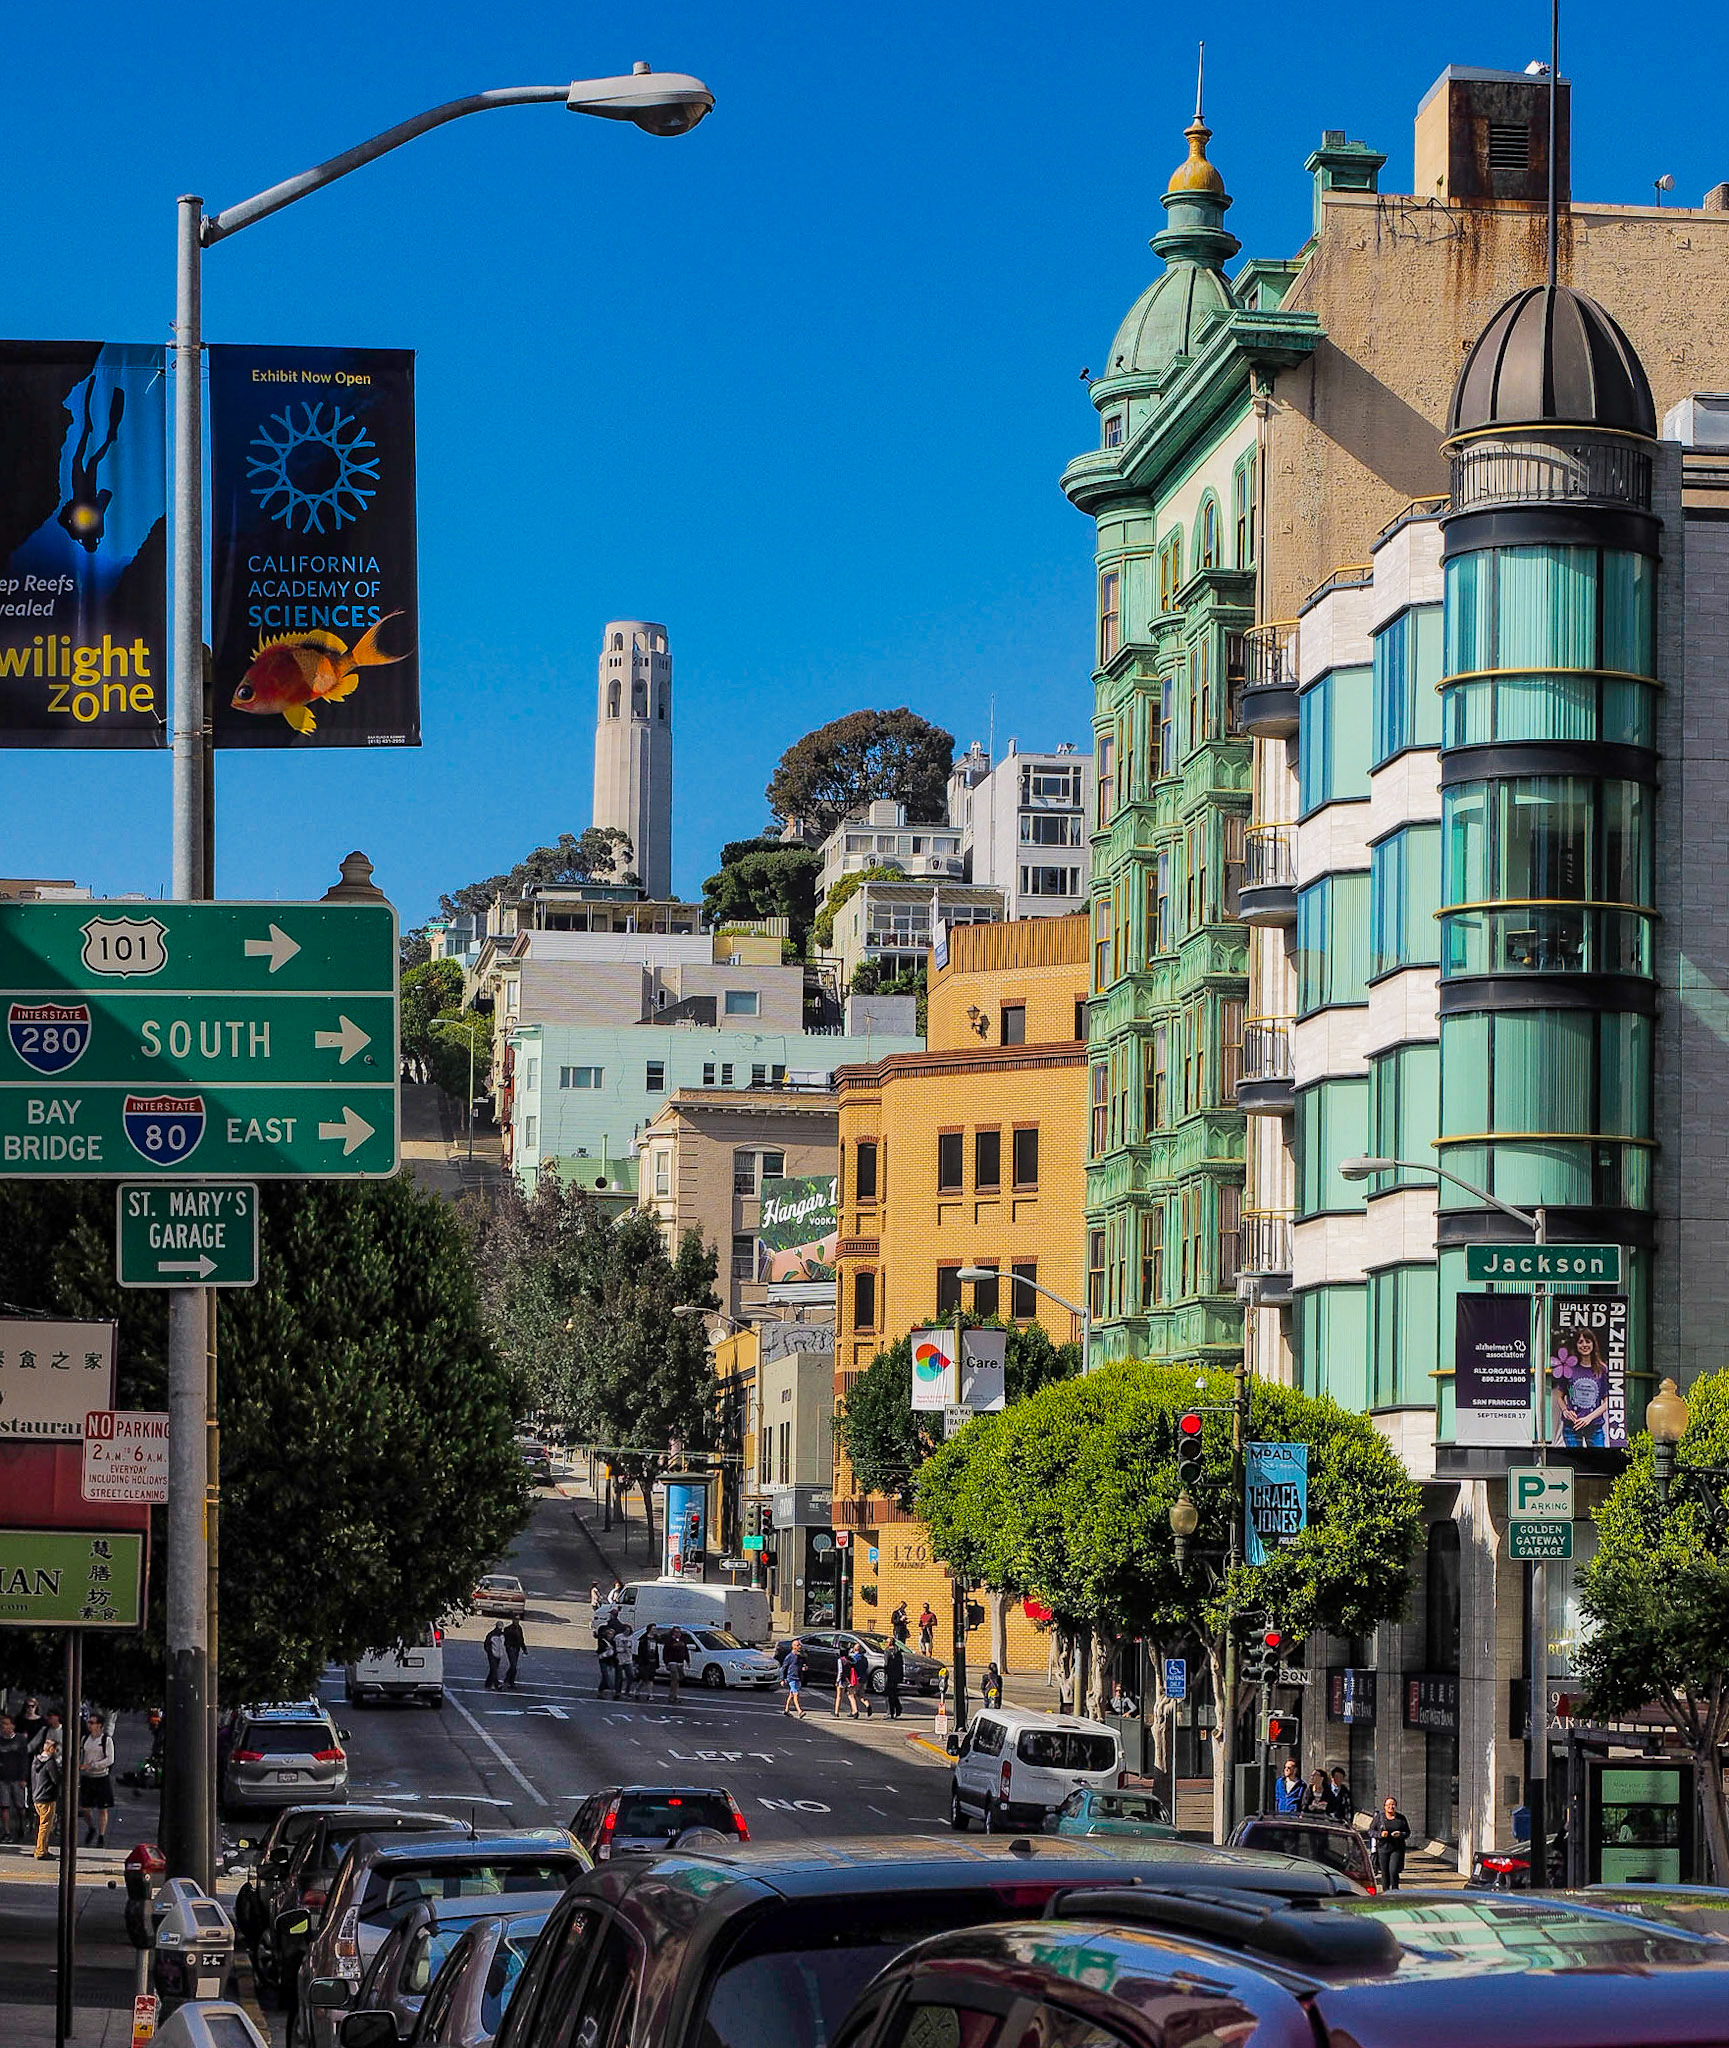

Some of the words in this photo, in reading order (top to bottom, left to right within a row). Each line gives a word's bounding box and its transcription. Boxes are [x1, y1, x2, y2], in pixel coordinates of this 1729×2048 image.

[252, 369, 298, 383] Exhibit
[301, 370, 332, 383] Now
[335, 371, 371, 386] Open
[248, 555, 380, 573] CALIFORNIA
[24, 575, 74, 595] Reefs
[248, 580, 351, 597] ACADEMY
[354, 581, 381, 597] OF
[248, 605, 381, 627] SCIENCES
[48, 683, 154, 723] zone
[100, 935, 147, 961] 101
[18, 1010, 81, 1020] INTERSTATE
[21, 1027, 81, 1054] 280
[141, 1020, 270, 1058] SOUTH
[27, 1100, 82, 1125] BAY
[132, 1102, 195, 1111] INTERSTATE
[145, 1125, 186, 1150] 80
[227, 1118, 297, 1143] EAST
[4, 1136, 103, 1161] BRIDGE
[128, 1192, 156, 1216] ST.
[170, 1191, 247, 1216] MARY'S
[762, 1192, 826, 1229] Hangar
[809, 1217, 837, 1226] VODKA
[149, 1223, 226, 1248] GARAGE
[1484, 1253, 1604, 1274] Jackson
[1560, 1303, 1590, 1311] WALK
[1592, 1303, 1607, 1311] TO
[1559, 1311, 1607, 1327] END
[1475, 1342, 1513, 1351] alzheimer's
[966, 1356, 1002, 1369] Care.
[1608, 1302, 1626, 1440] ALZHEIMER'S
[88, 1415, 111, 1437] NO
[93, 1444, 102, 1460] 2
[134, 1446, 143, 1462] 6
[111, 1465, 147, 1474] EVERYDAY
[89, 1474, 129, 1484] INCLUDING
[132, 1476, 167, 1485] HOLIDAYS
[90, 1489, 121, 1498] STREET
[124, 1490, 165, 1499] CLEANING
[1254, 1486, 1298, 1509] GRACE
[1255, 1510, 1298, 1533] JONES
[1520, 1525, 1562, 1534] GOLDEN
[1515, 1536, 1566, 1545] GATEWAY
[894, 1546, 926, 1561] 170
[1519, 1547, 1563, 1555] GARAGE
[668, 1749, 776, 1763] LEFT
[756, 1797, 832, 1813] NO
